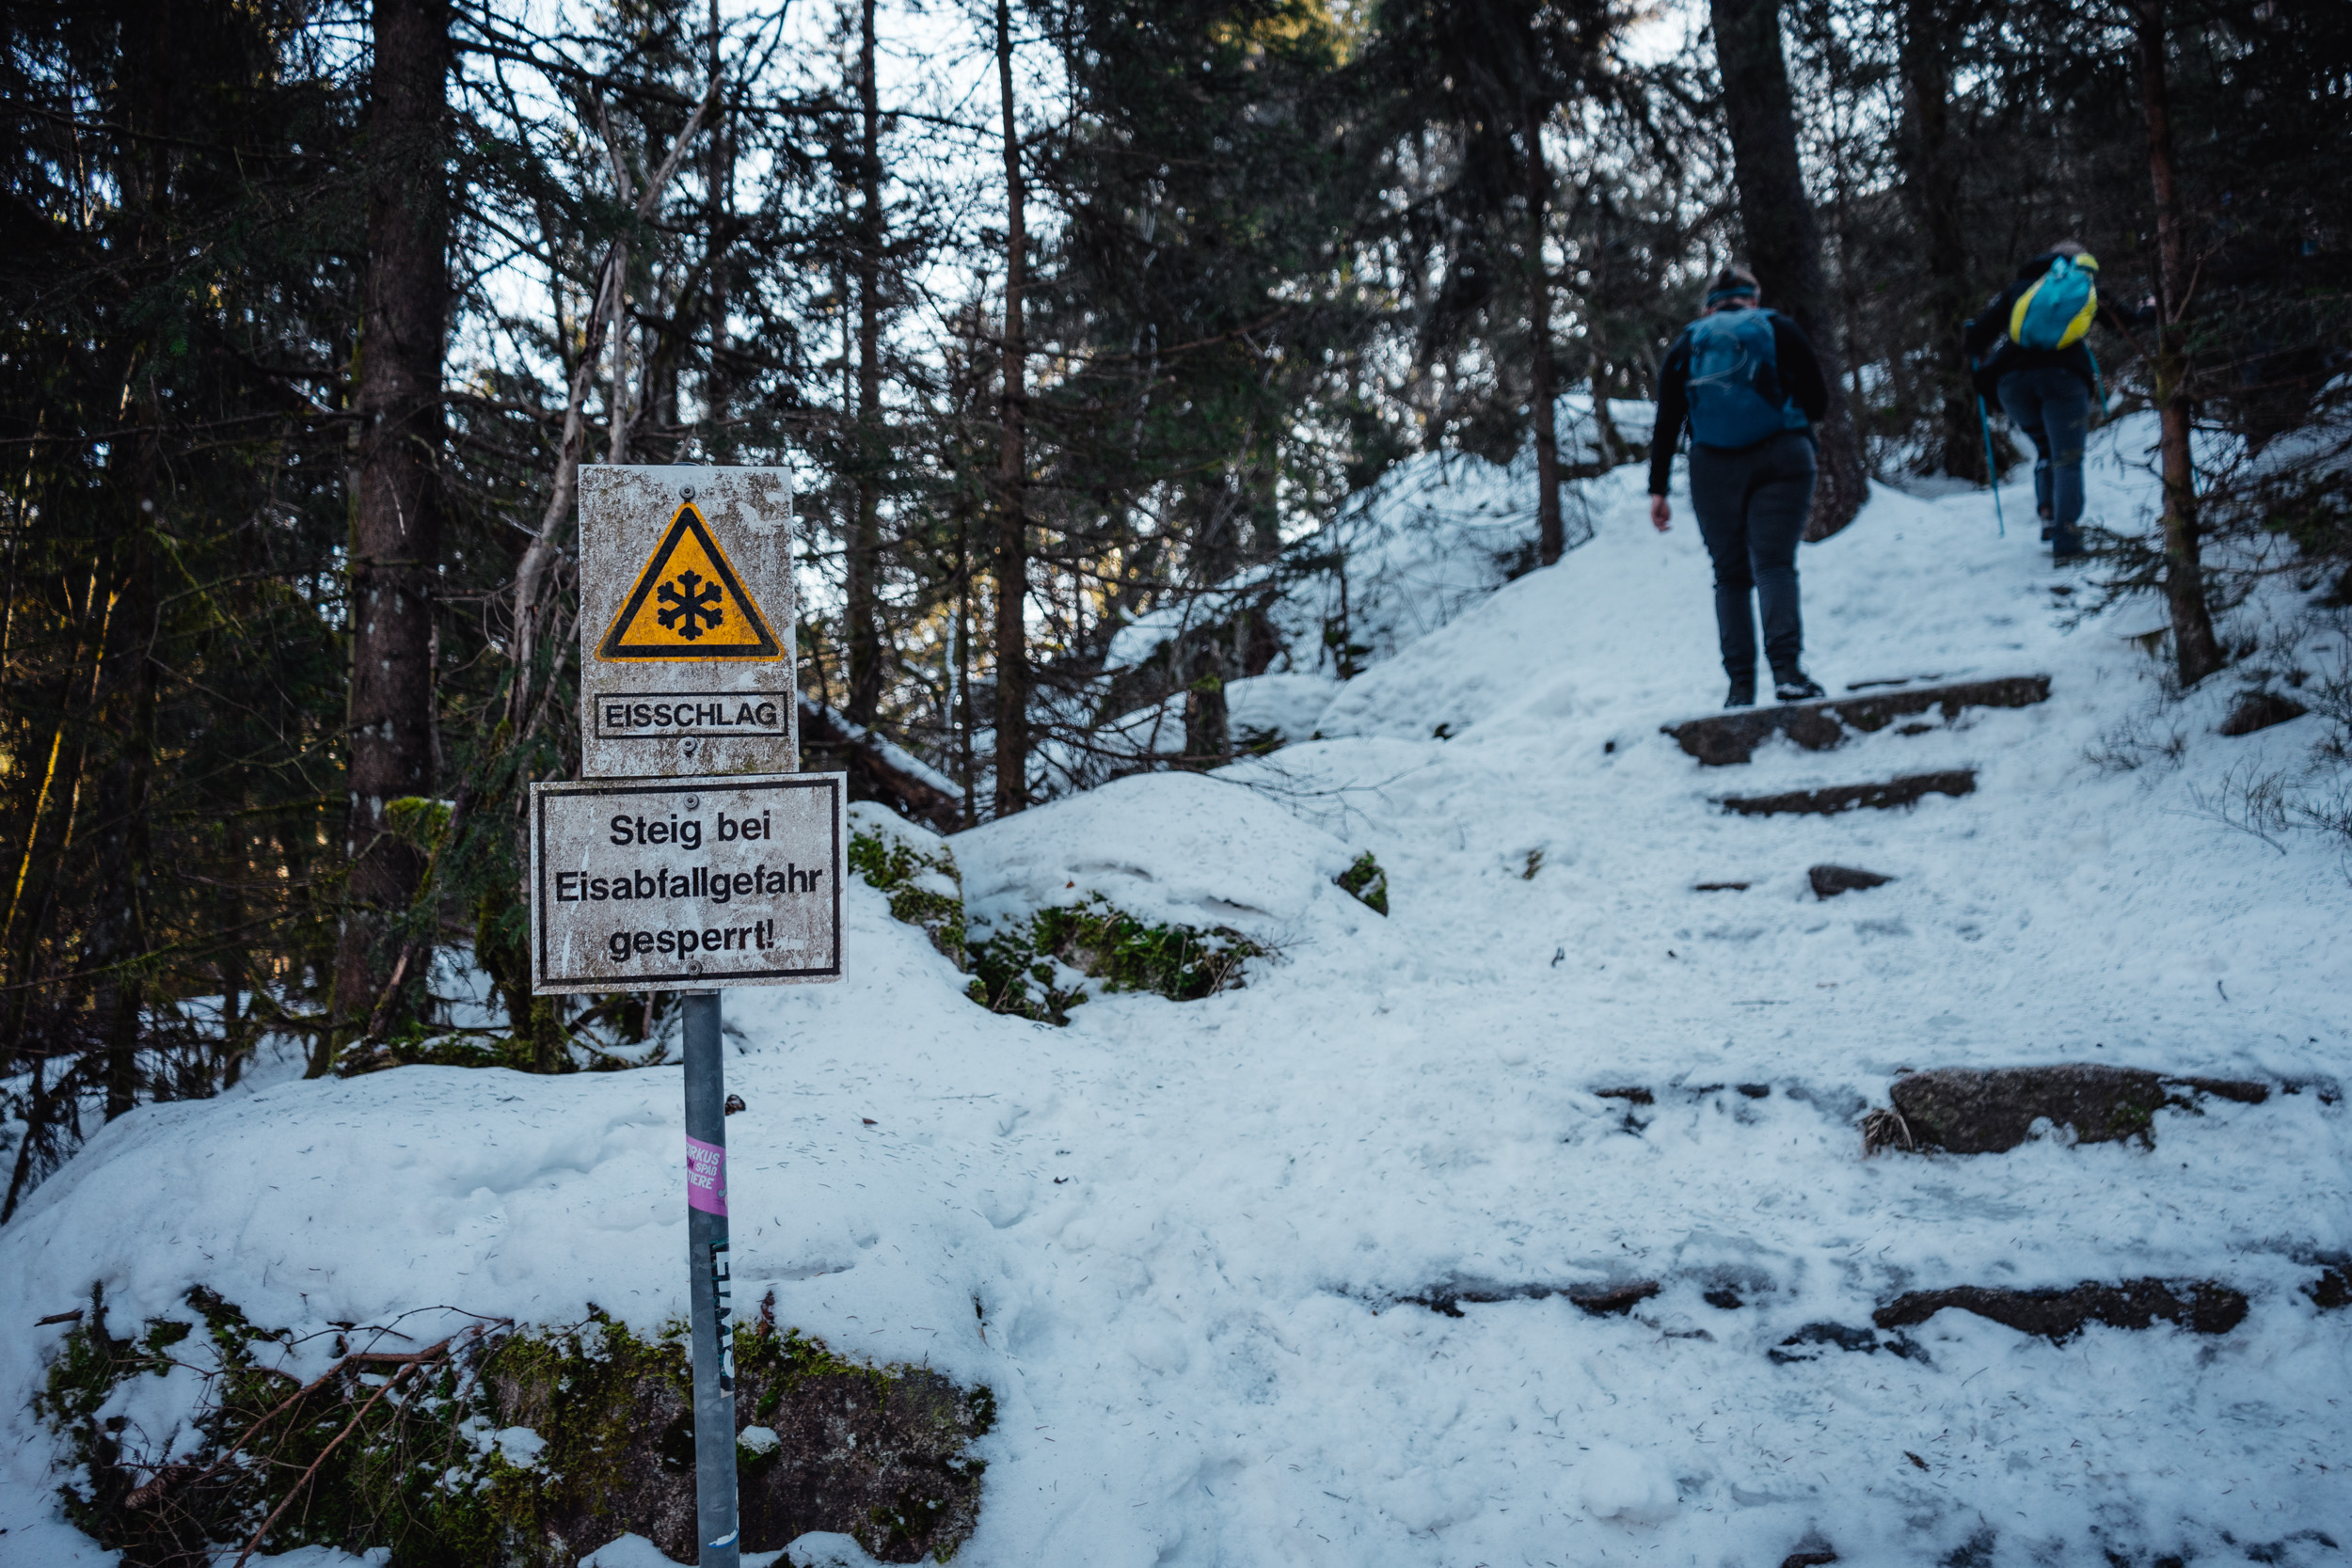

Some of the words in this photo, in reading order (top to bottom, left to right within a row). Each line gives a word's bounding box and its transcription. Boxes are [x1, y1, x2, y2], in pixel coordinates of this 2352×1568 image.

[605, 702, 778, 728] EISSCHLAG
[610, 814, 702, 851] Steig
[717, 810, 771, 842] bei
[555, 863, 823, 905] Eisabfallgefahr
[609, 919, 774, 962] gesperrt!
